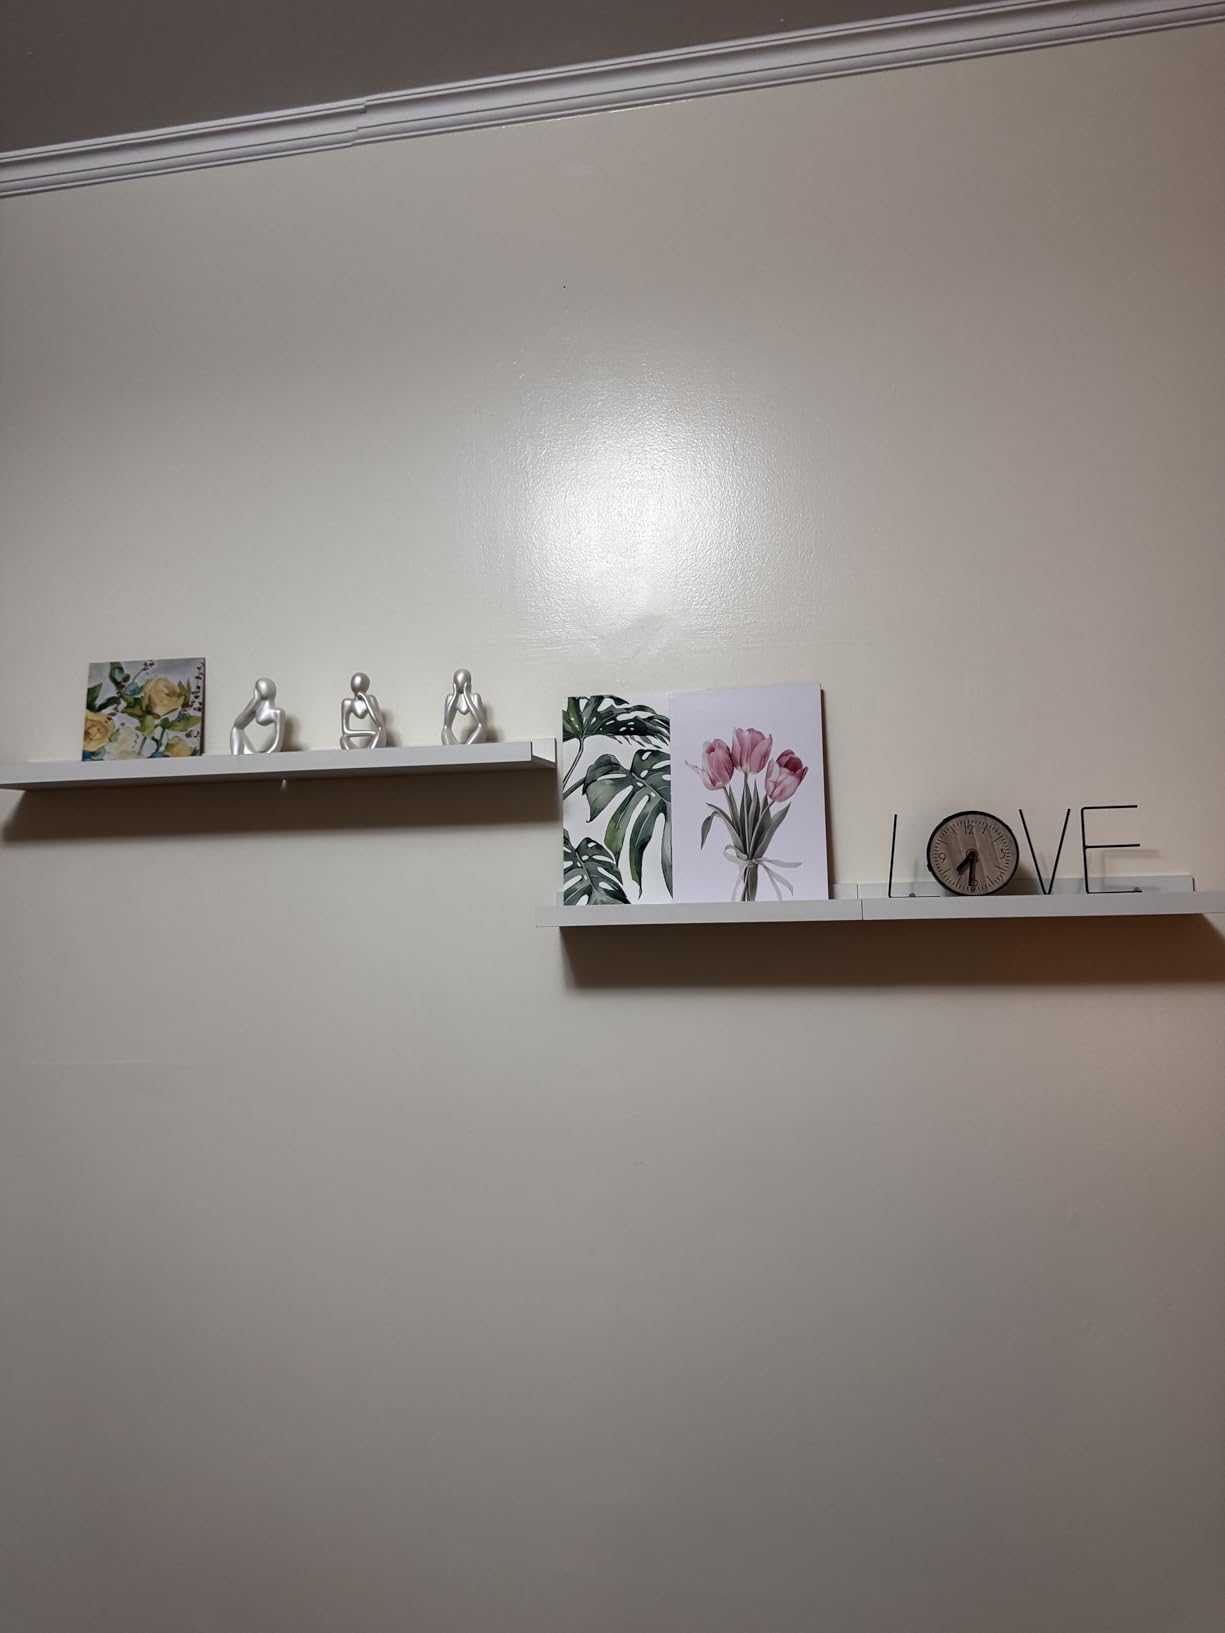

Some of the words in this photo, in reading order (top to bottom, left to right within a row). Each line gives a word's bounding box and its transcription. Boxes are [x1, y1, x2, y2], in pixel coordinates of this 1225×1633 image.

[964, 824, 974, 835] 12
[938, 852, 947, 863] 9
[999, 848, 1006, 860] 3
